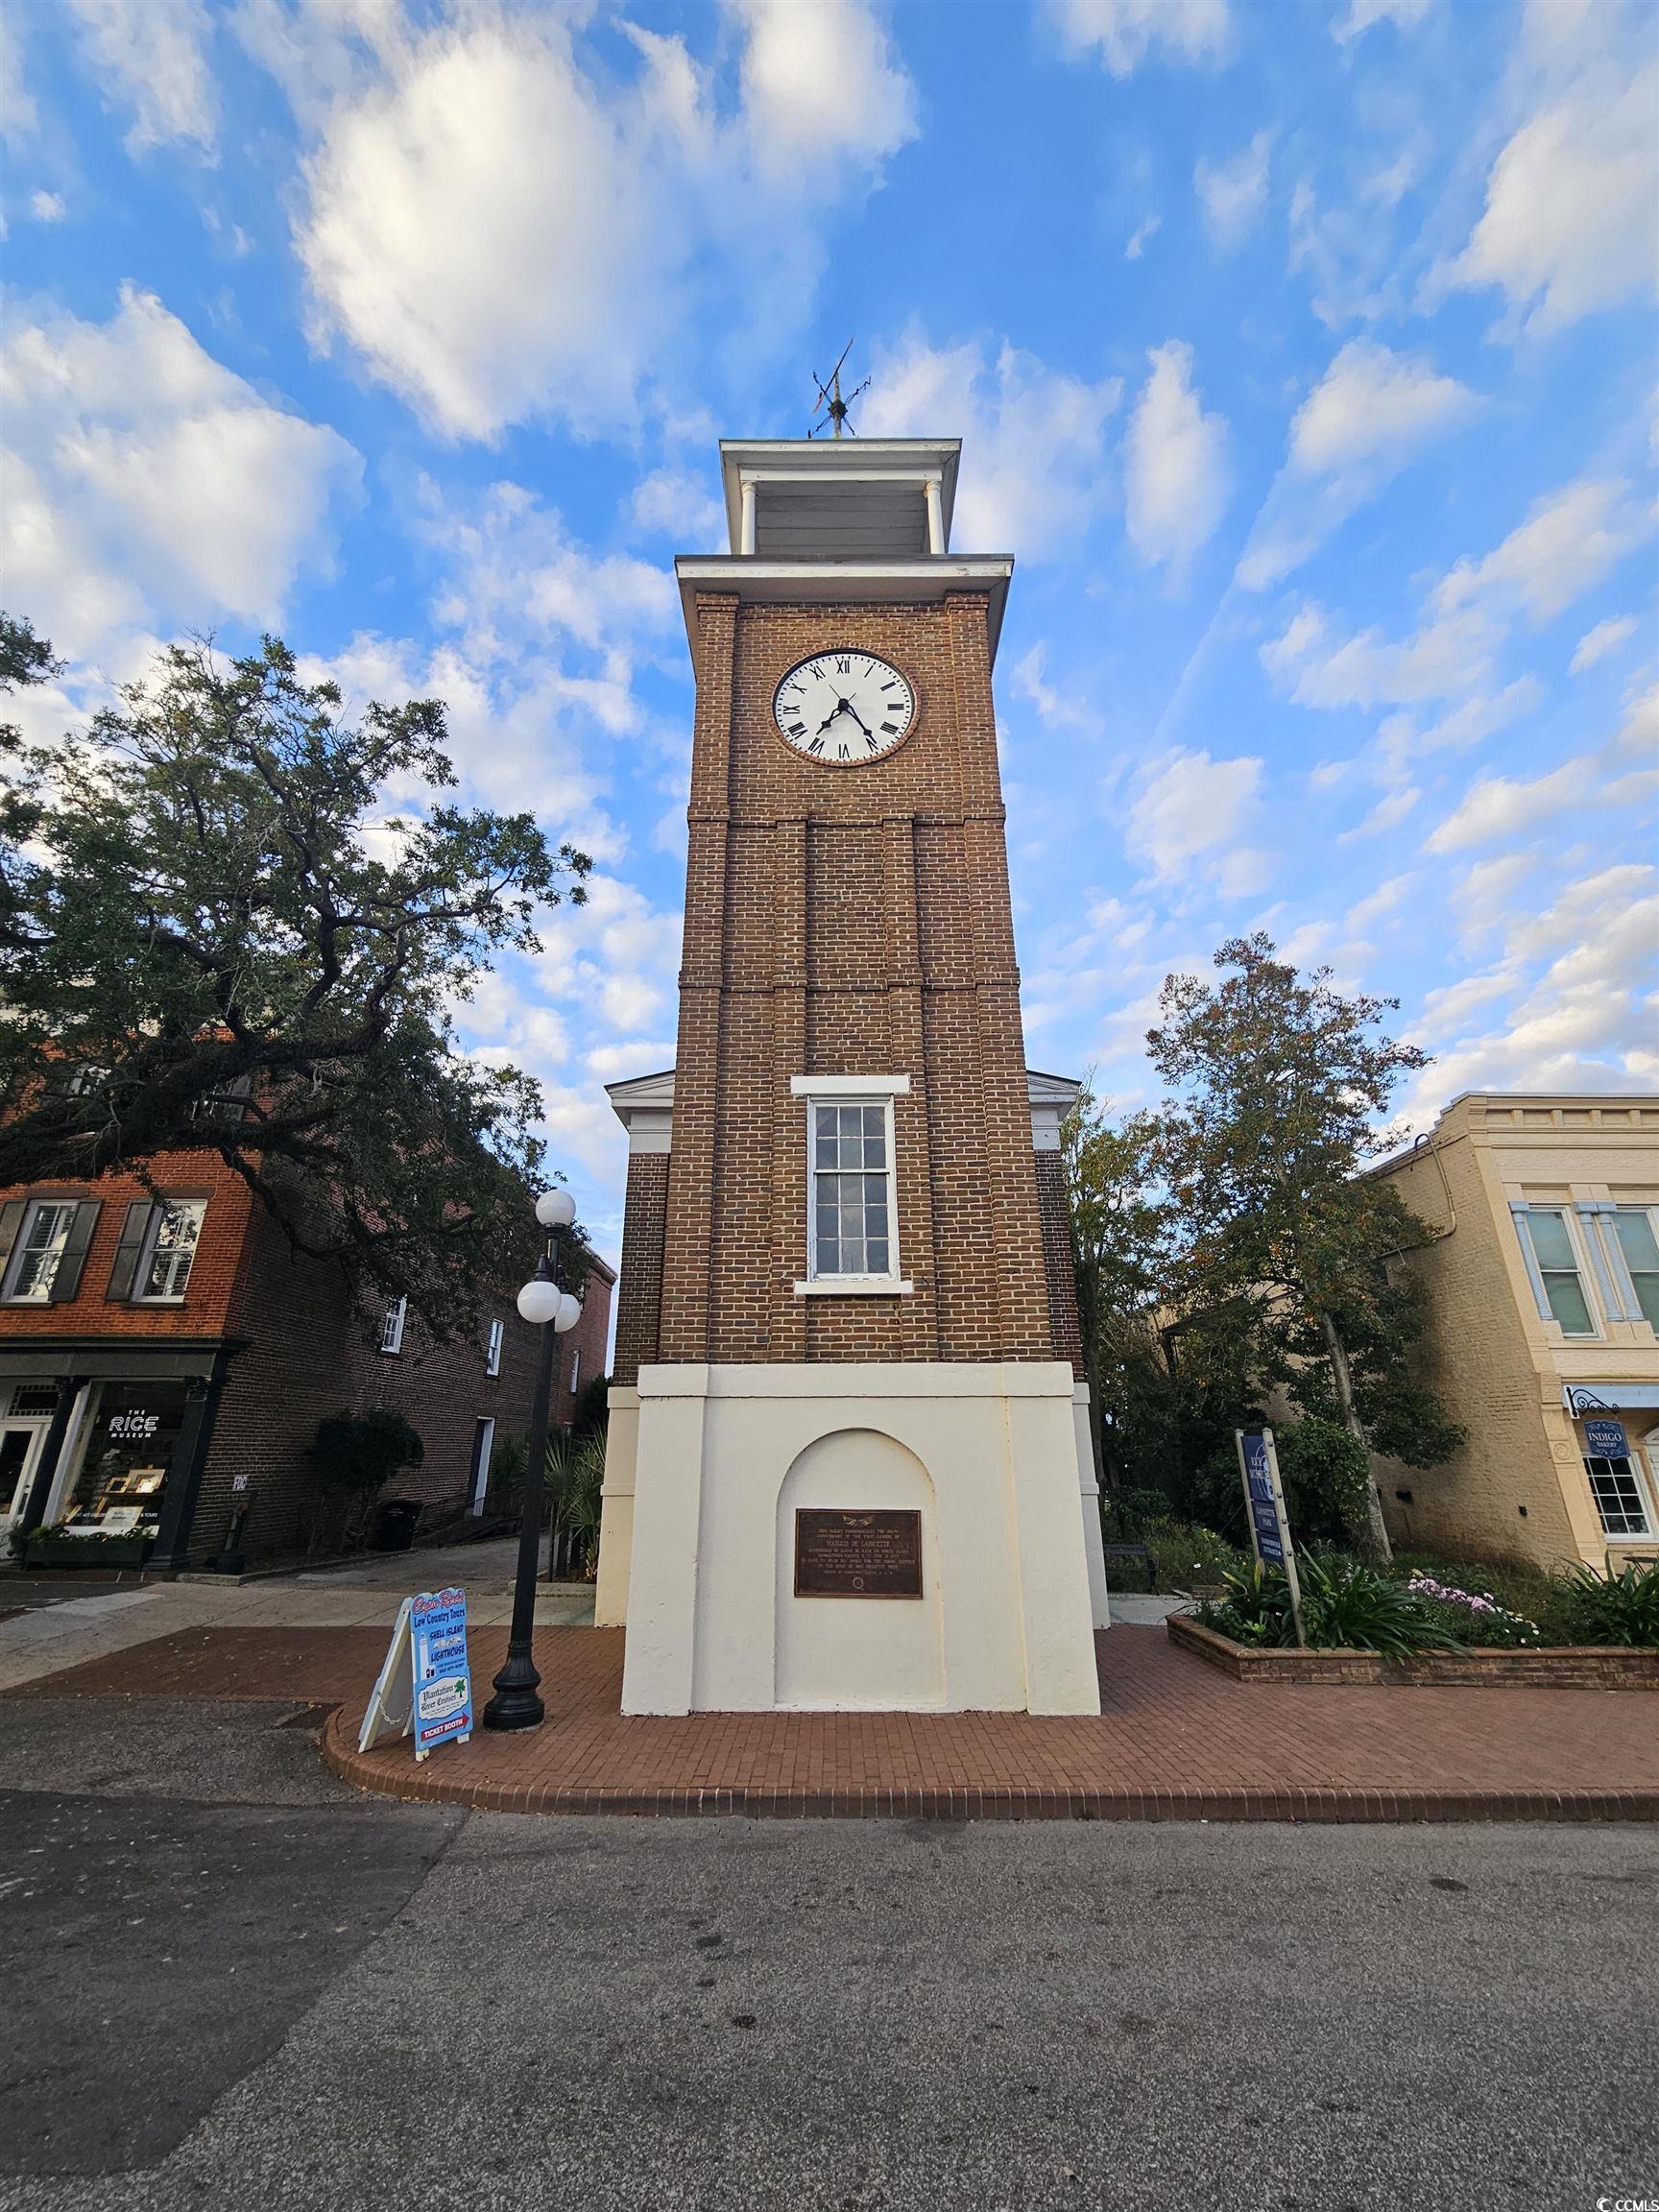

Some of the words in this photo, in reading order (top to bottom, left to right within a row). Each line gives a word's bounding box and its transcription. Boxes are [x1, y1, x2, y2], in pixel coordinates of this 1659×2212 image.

[809, 666, 826, 681] XI
[837, 661, 850, 674] XII
[790, 684, 807, 694] X
[783, 706, 800, 714] IX
[787, 722, 808, 739] VIII
[808, 737, 825, 755] VII
[839, 744, 850, 758] VI
[108, 1416, 159, 1431] RICE
[1588, 1432, 1622, 1441] INDIGO
[414, 1617, 426, 1628] Low
[427, 1612, 449, 1624] Country
[450, 1609, 466, 1620] Tours
[430, 1629, 445, 1641] SHELL
[445, 1624, 465, 1636] ISLAND
[431, 1645, 466, 1663] LIGHTHOUSE
[423, 1685, 454, 1702] Plantation
[437, 1695, 457, 1706] Cruises
[424, 1725, 444, 1739] TICKET
[445, 1719, 463, 1732] BOOTH
